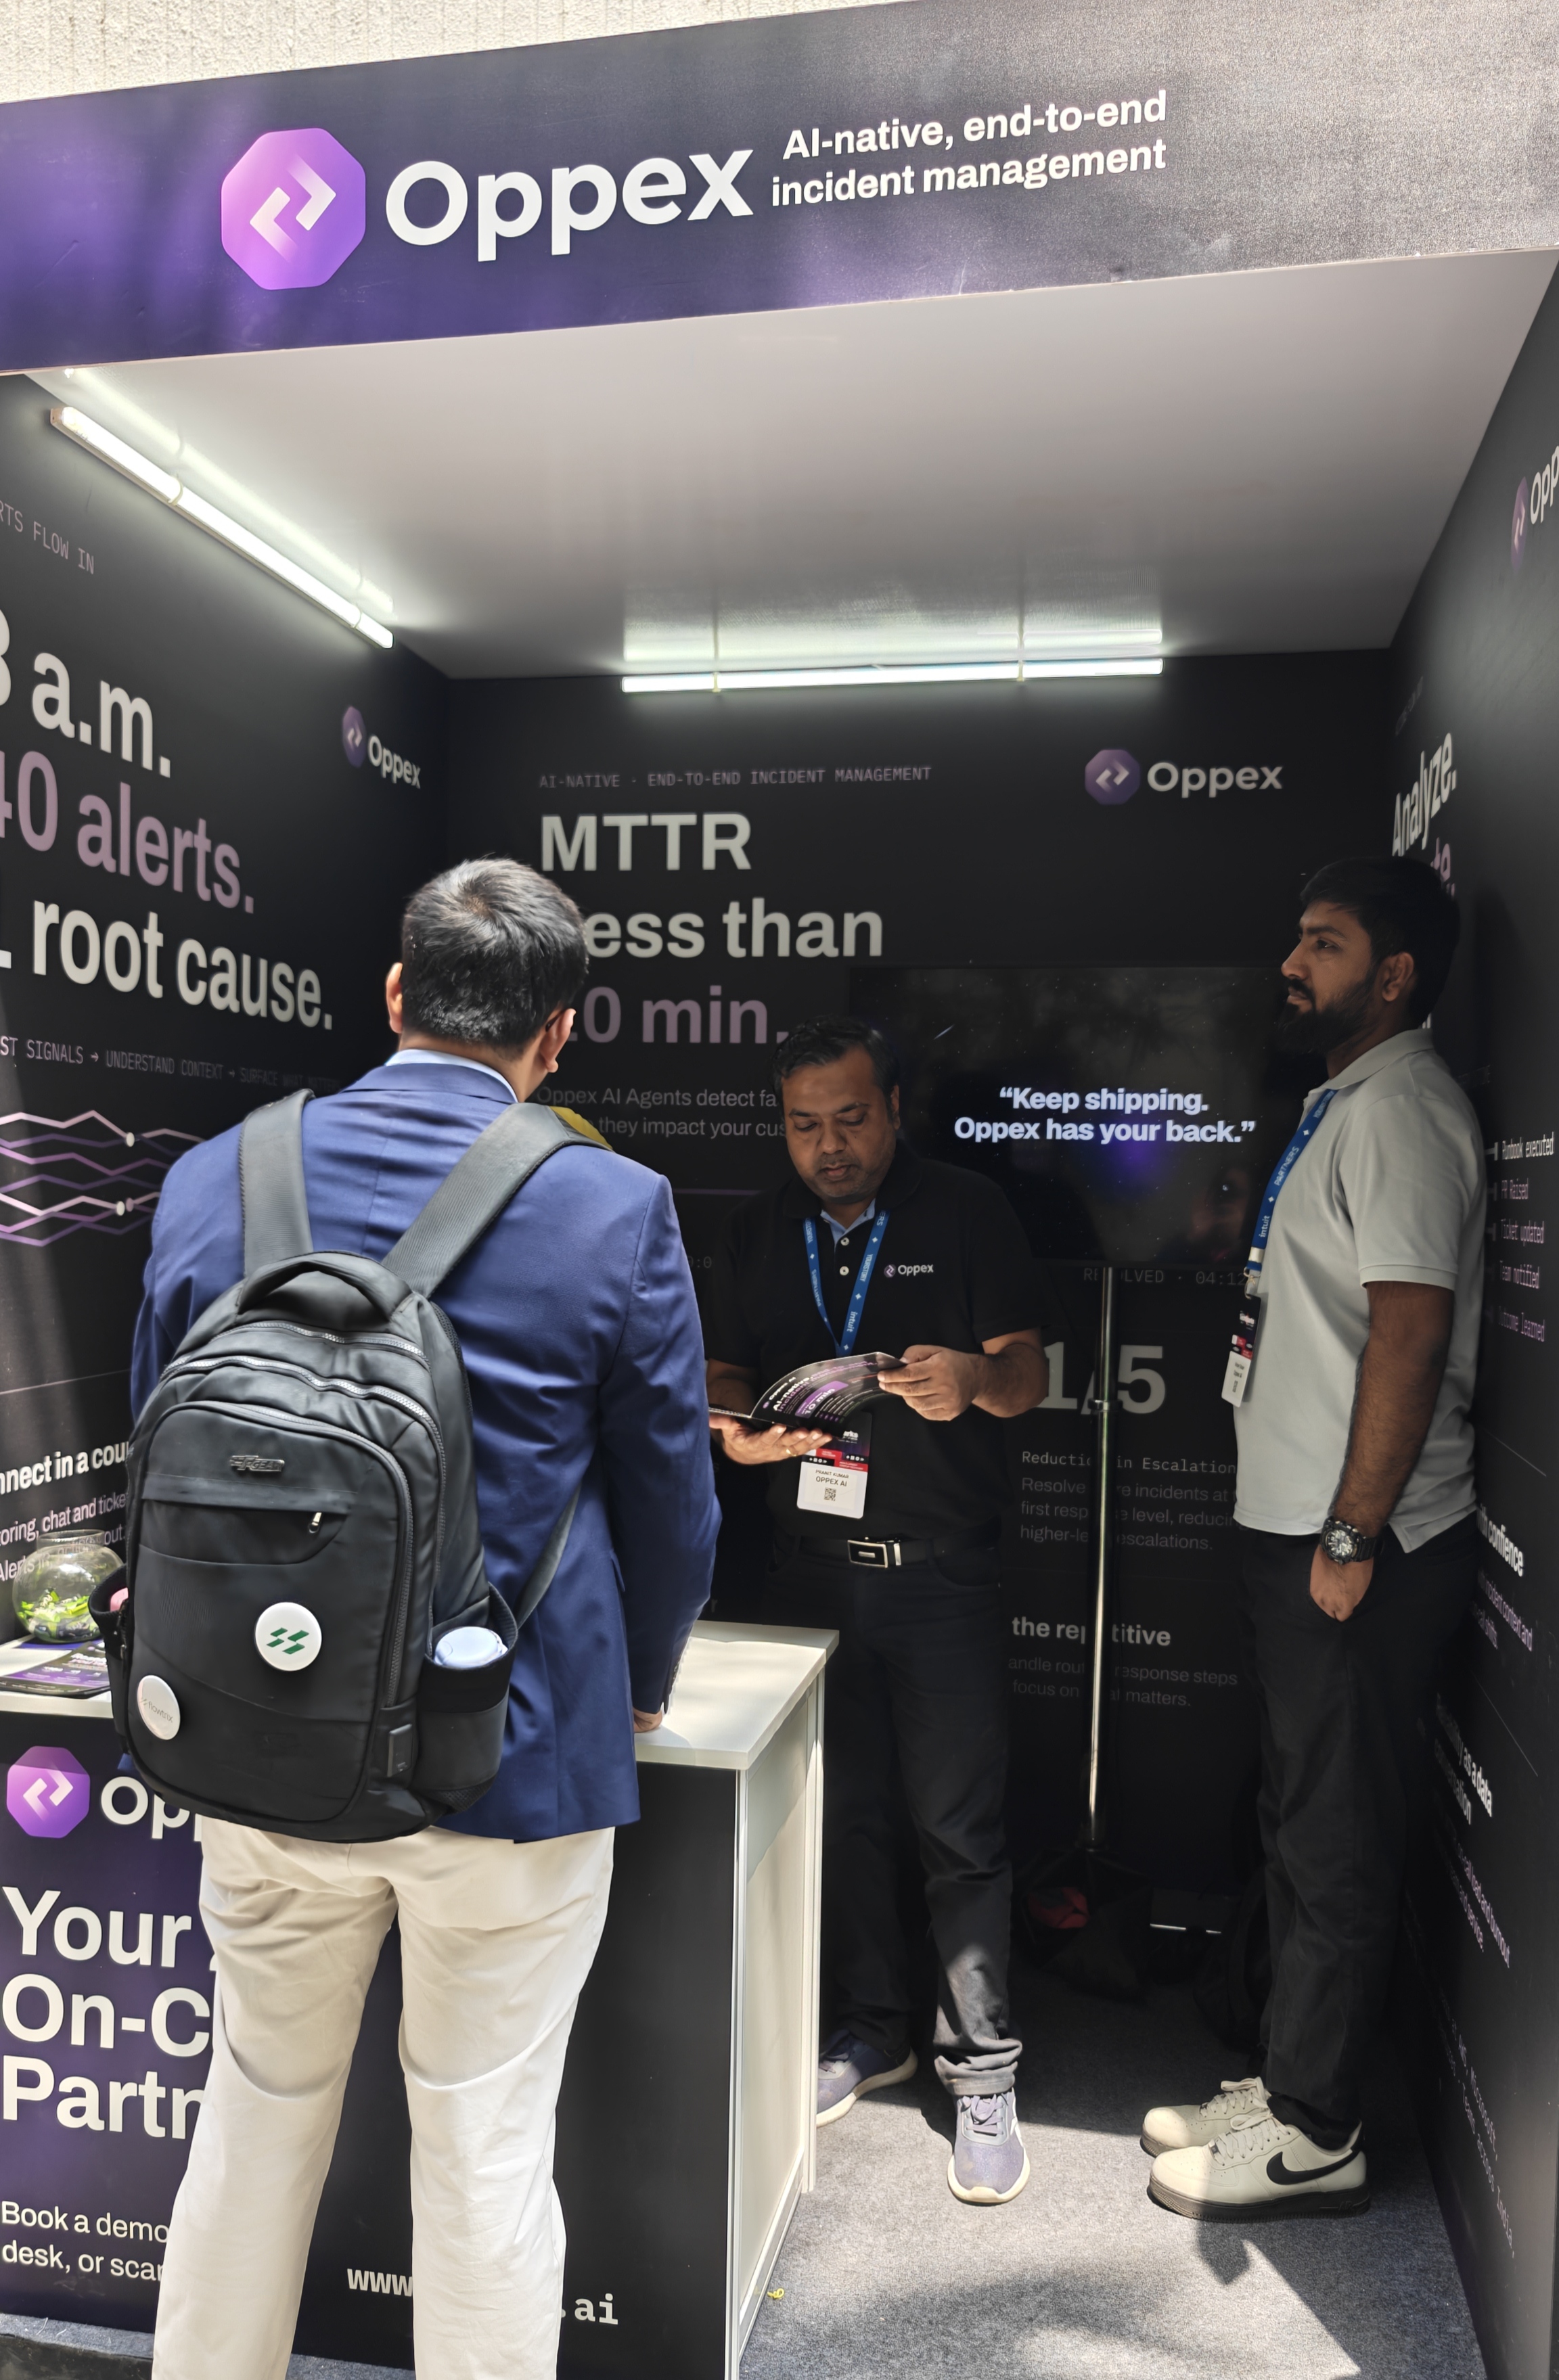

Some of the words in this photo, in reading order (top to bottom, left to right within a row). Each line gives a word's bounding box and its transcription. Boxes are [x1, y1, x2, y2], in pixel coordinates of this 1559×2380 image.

[783, 118, 953, 160] AI-native,
[964, 90, 1167, 143] end-to-end
[772, 165, 914, 206] incident
[923, 139, 1166, 190] management
[386, 150, 753, 262] Oppex
[34, 520, 68, 559] FLOW
[78, 547, 94, 574] IN
[32, 652, 171, 778] a.m.
[368, 735, 421, 789] Oppex
[540, 774, 620, 788] AI-NATIVE
[648, 771, 741, 787] END-TO-END
[750, 769, 826, 785] INCIDENT
[834, 766, 932, 782] MANAGEMENT
[1147, 762, 1283, 798] Oppex
[1392, 732, 1458, 857] Analyze.
[0, 749, 58, 851] 0
[77, 781, 254, 914] alerts.
[542, 813, 752, 871] MTTR
[585, 912, 705, 958] ess
[722, 898, 882, 958] than
[34, 900, 164, 999] root
[177, 938, 332, 1030] cause.
[567, 986, 621, 1043] 0
[642, 984, 790, 1044] min.
[26, 1040, 84, 1065] SIGNALS
[106, 1050, 175, 1075] UNDERSTAND
[181, 1058, 224, 1080] CONTEXT
[537, 1086, 597, 1105] Oppex
[602, 1088, 620, 1104] AI
[626, 1088, 692, 1108] Agents
[696, 1089, 755, 1107] detect
[1085, 1088, 1209, 1115] shipping.
[598, 1116, 638, 1138] they
[643, 1117, 705, 1138] impact
[710, 1122, 752, 1139] your
[954, 1117, 1041, 1143] Oppex
[1047, 1118, 1094, 1140] has
[1101, 1123, 1161, 1144] your
[1274, 1146, 1299, 1186] PARTNERS
[1259, 1215, 1270, 1237] intuit
[897, 1264, 934, 1277] Oppex
[1083, 1267, 1164, 1283] RLVED
[846, 1311, 858, 1333] intuit
[53, 1451, 74, 1480] in
[76, 1452, 90, 1474] a
[1022, 1450, 1091, 1467] Reductio
[815, 1476, 838, 1486] OPPEX
[1022, 1478, 1086, 1494] Resolve
[1135, 1483, 1208, 1501] incidents
[1213, 1488, 1231, 1502] at
[0, 1518, 39, 1547] oring,
[42, 1507, 71, 1533] chat
[73, 1497, 97, 1524] and
[99, 1492, 128, 1515] ticke
[1021, 1501, 1050, 1516] first
[1133, 1507, 1173, 1526] level,
[1179, 1511, 1248, 1531] reduci
[104, 1524, 126, 1546] out.
[1012, 1616, 1050, 1639] the
[1008, 1657, 1052, 1672] andle
[1193, 1670, 1238, 1687] steps
[1013, 1678, 1056, 1696] focus
[1059, 1685, 1080, 1697] on
[1125, 1691, 1191, 1707] matters.
[1464, 1746, 1472, 1777] as
[1477, 1766, 1493, 1818] data
[101, 1776, 202, 1841] Op
[2, 1886, 192, 1967] Your
[1, 2201, 69, 2231] Book
[74, 2214, 90, 2234] a
[96, 2212, 170, 2243] demo
[2, 2239, 70, 2274] desk,
[78, 2253, 104, 2274] or
